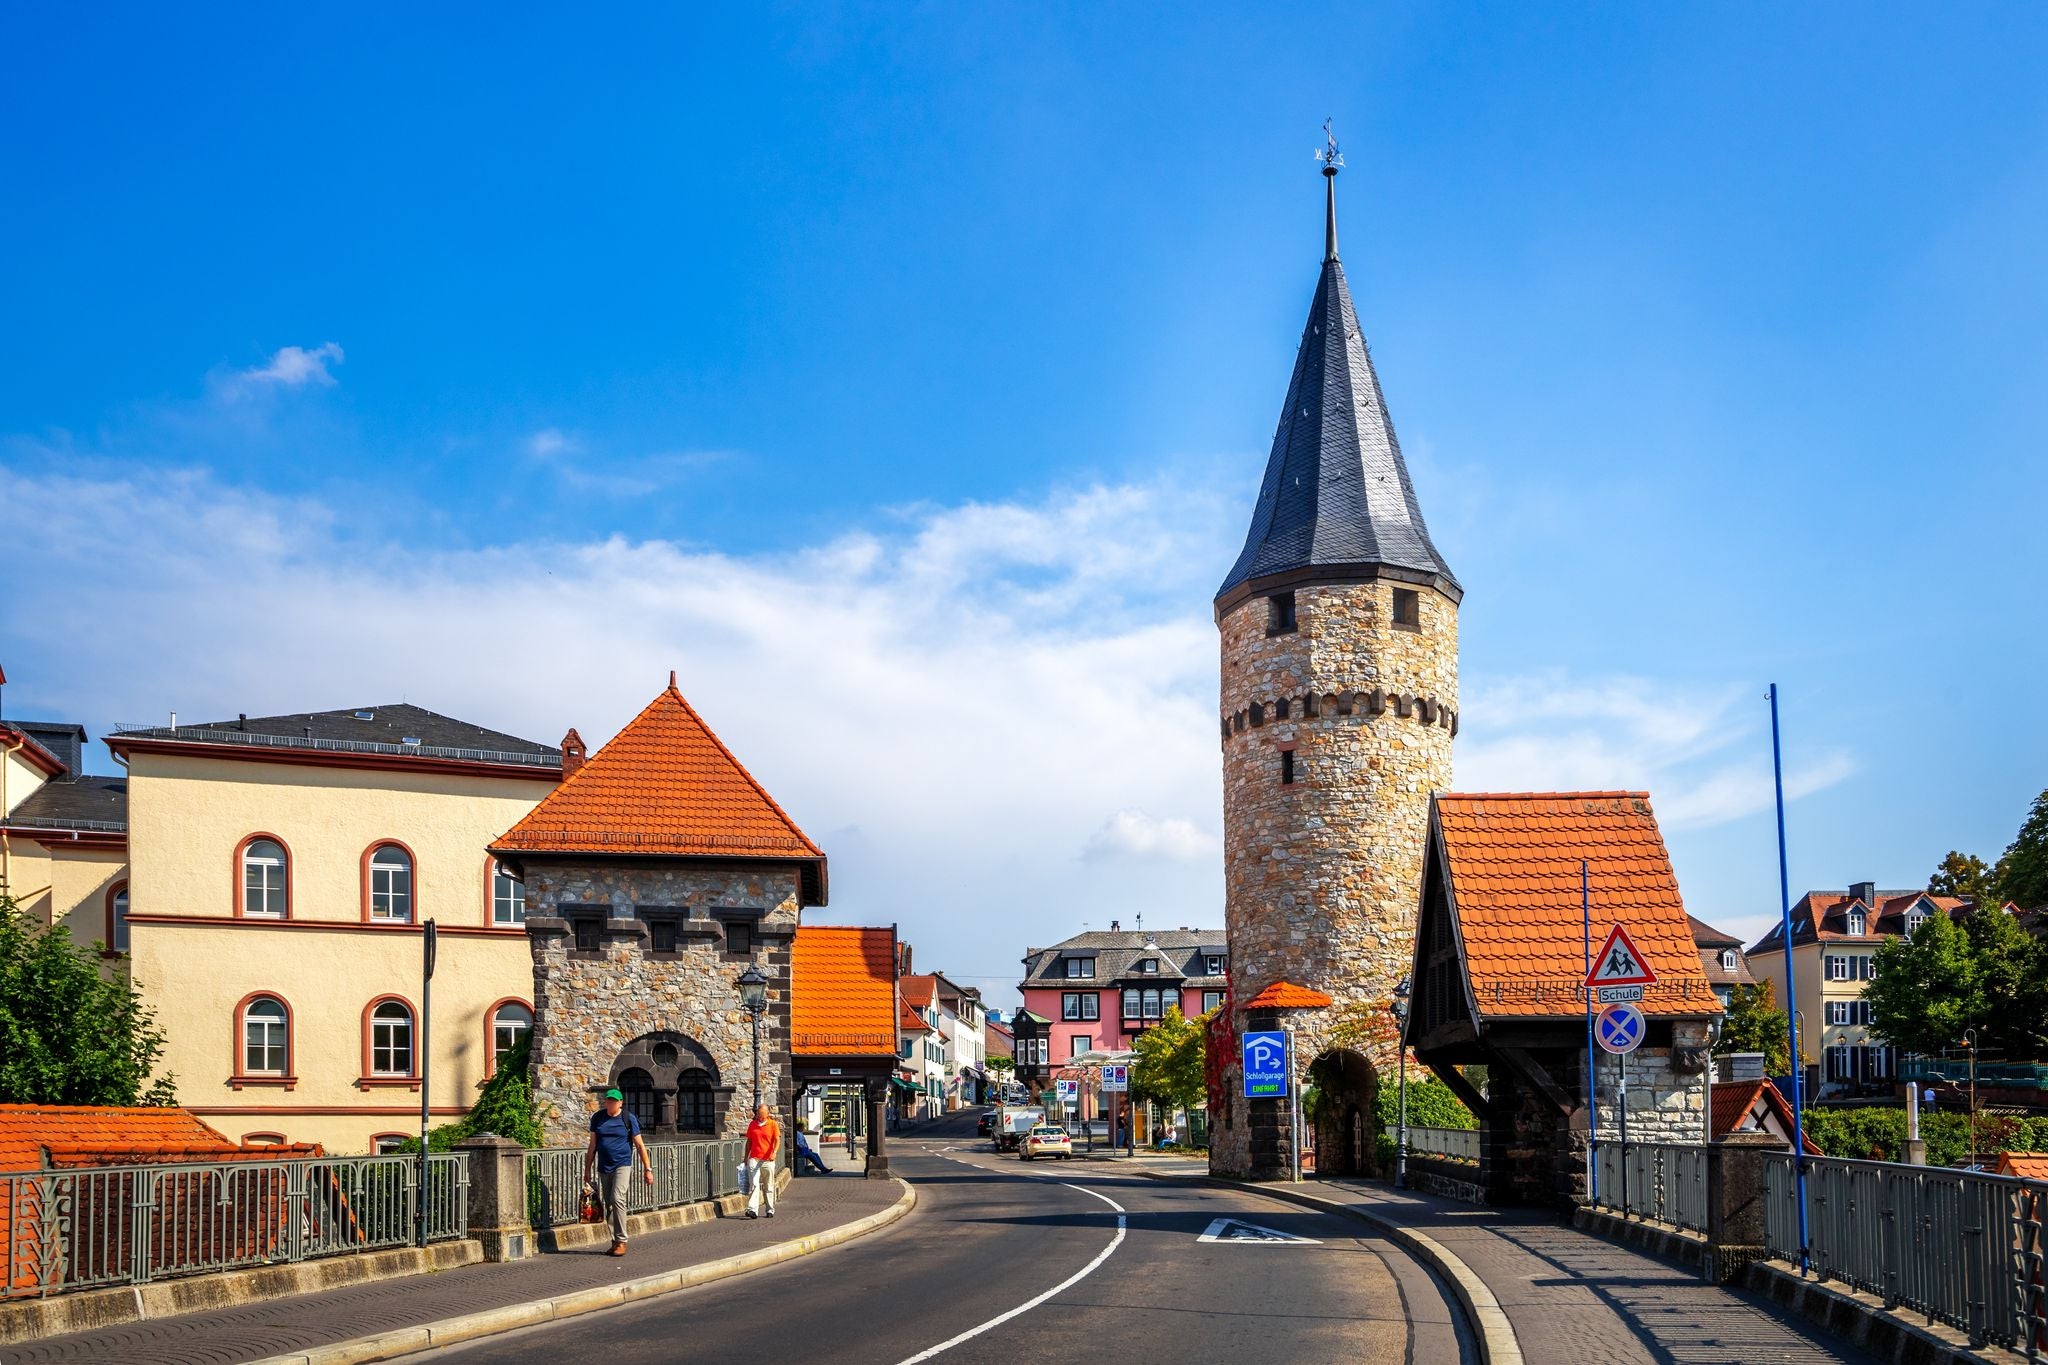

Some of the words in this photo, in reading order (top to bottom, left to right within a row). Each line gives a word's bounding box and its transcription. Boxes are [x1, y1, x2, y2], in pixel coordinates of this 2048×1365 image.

[1602, 989, 1639, 1000] Schule
[1254, 1046, 1271, 1069] P
[1104, 1067, 1112, 1077] P
[1246, 1072, 1284, 1081] Schloßgarage
[1059, 1081, 1066, 1090] P
[1252, 1085, 1279, 1093] EINFAHRT
